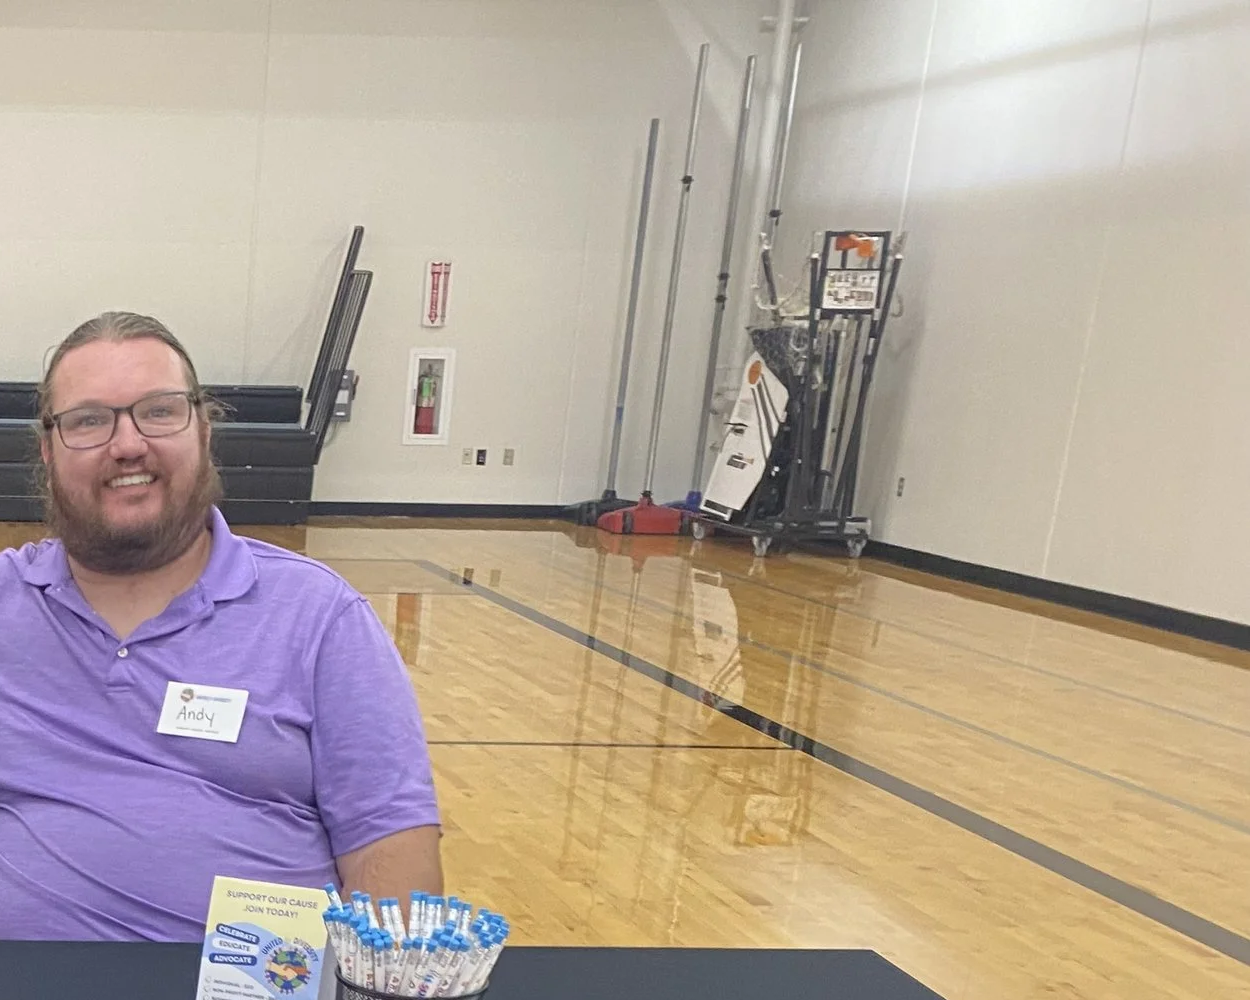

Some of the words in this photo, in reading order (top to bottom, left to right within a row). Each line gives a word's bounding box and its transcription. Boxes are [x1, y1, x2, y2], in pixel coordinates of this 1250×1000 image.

[176, 705, 215, 728] Andy
[227, 890, 267, 902] SUPPORT
[268, 896, 288, 905] OUR
[289, 899, 318, 909] CAUSE
[243, 905, 264, 914] JOIN
[266, 907, 299, 918] TODAY!
[219, 926, 257, 943] CELEBRATE
[219, 940, 251, 952] EDUCATE
[262, 937, 284, 955] UNITED
[293, 937, 318, 961] DIVERSITY
[214, 954, 252, 964] ADVOCATE
